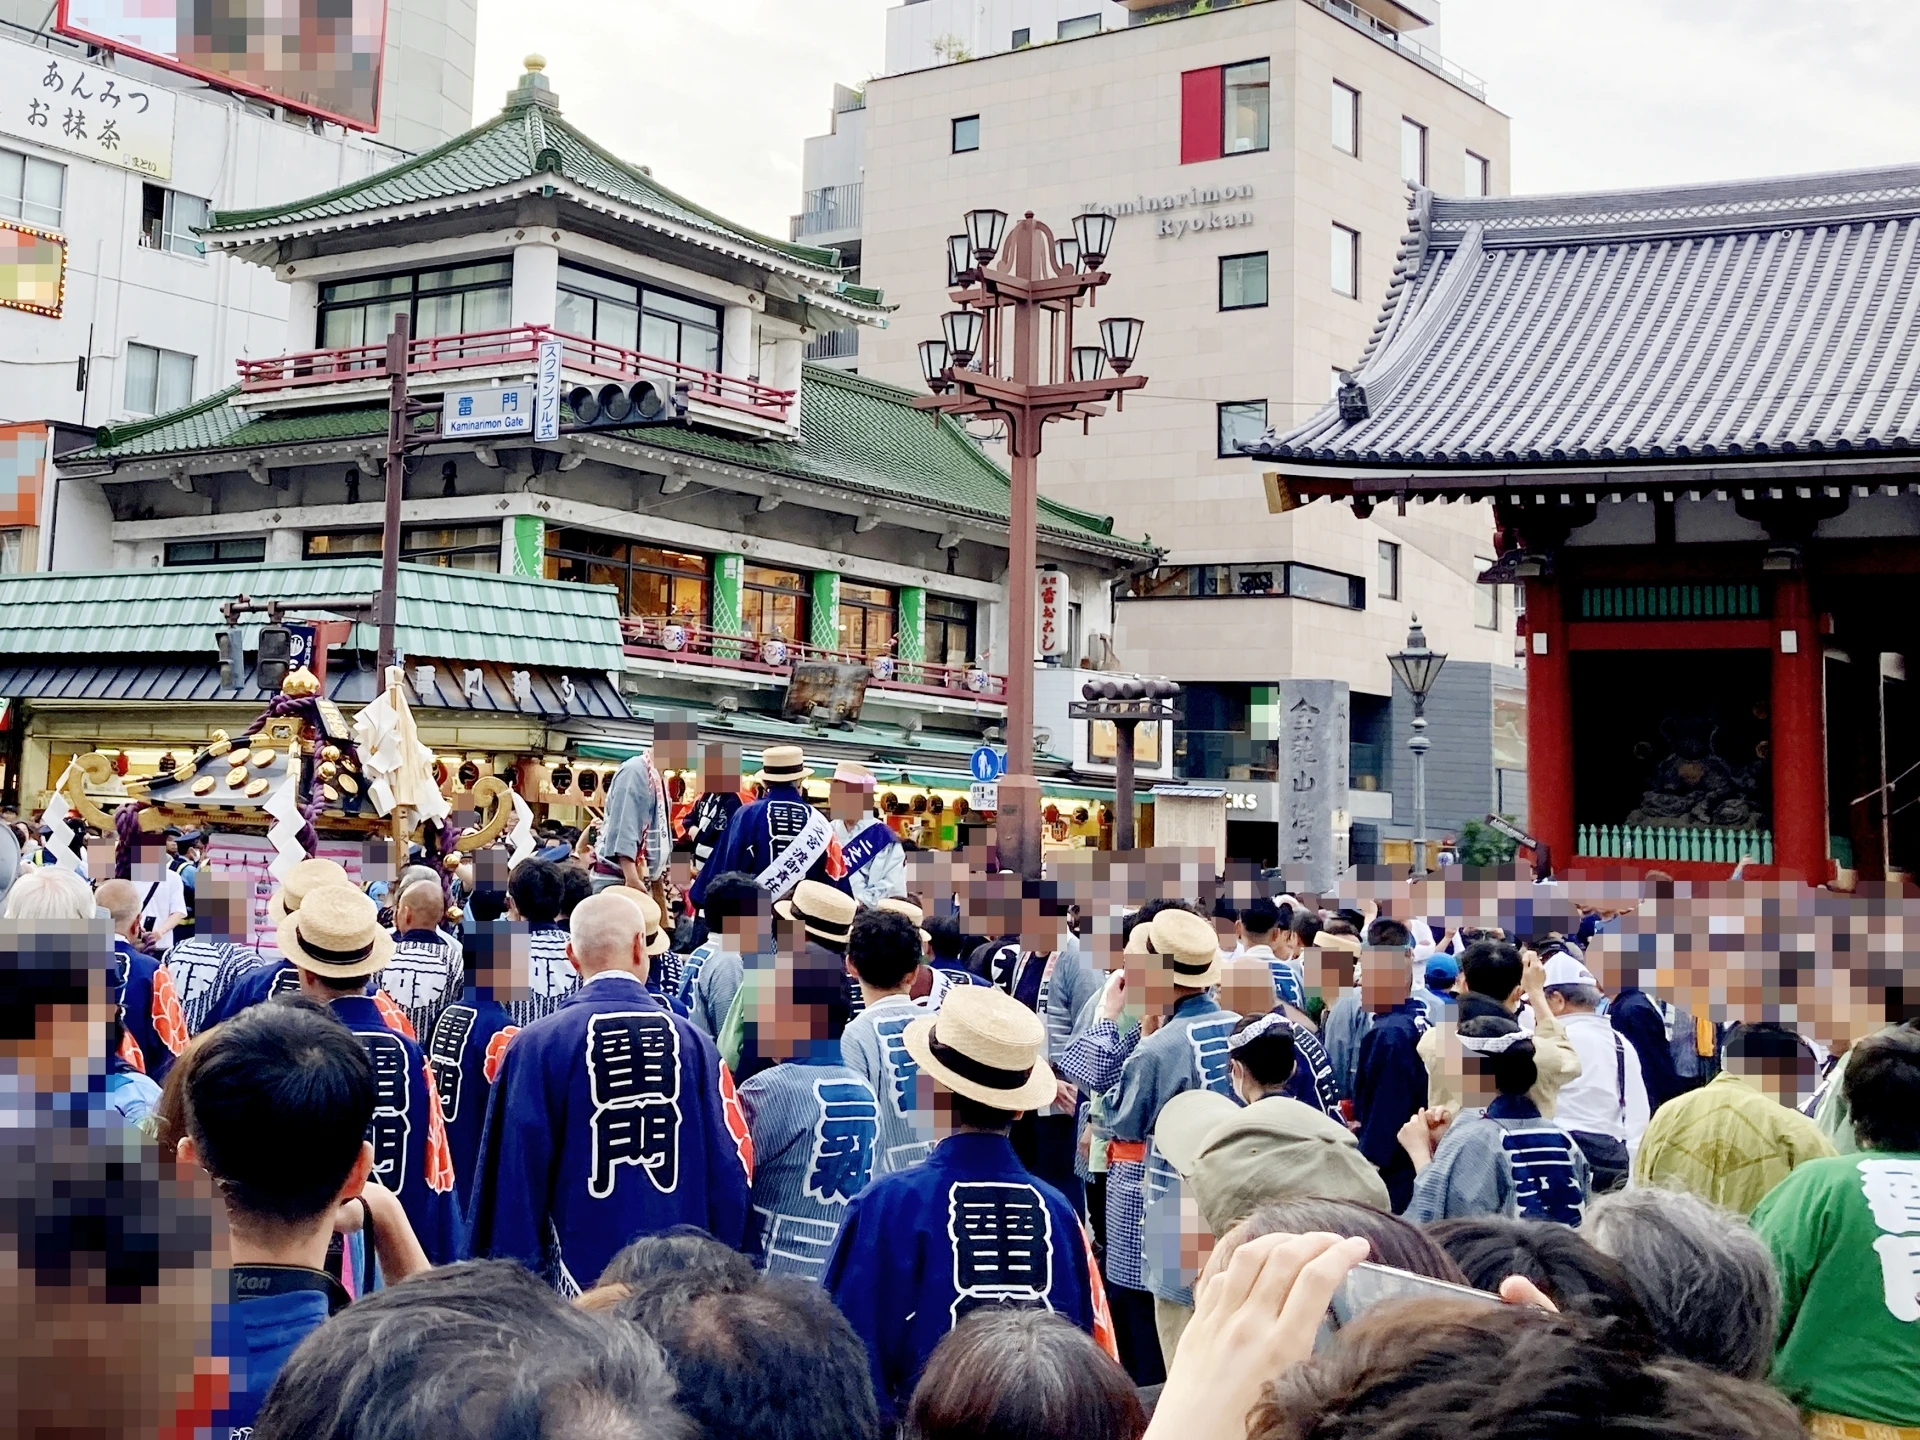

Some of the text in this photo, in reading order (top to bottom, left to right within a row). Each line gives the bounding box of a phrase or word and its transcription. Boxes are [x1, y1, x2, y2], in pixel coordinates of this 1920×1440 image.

[42, 60, 150, 114] あんみつ
[27, 97, 121, 151] お抹茶
[1157, 210, 1253, 240] Ryokan
[458, 391, 518, 417] 雷門
[540, 345, 557, 437] スクランブル式
[450, 416, 524, 432] Kaminarimon Gate
[1041, 586, 1057, 651] 雷おこし
[586, 1011, 683, 1199] 雷門
[947, 1181, 1054, 1331] 雷
